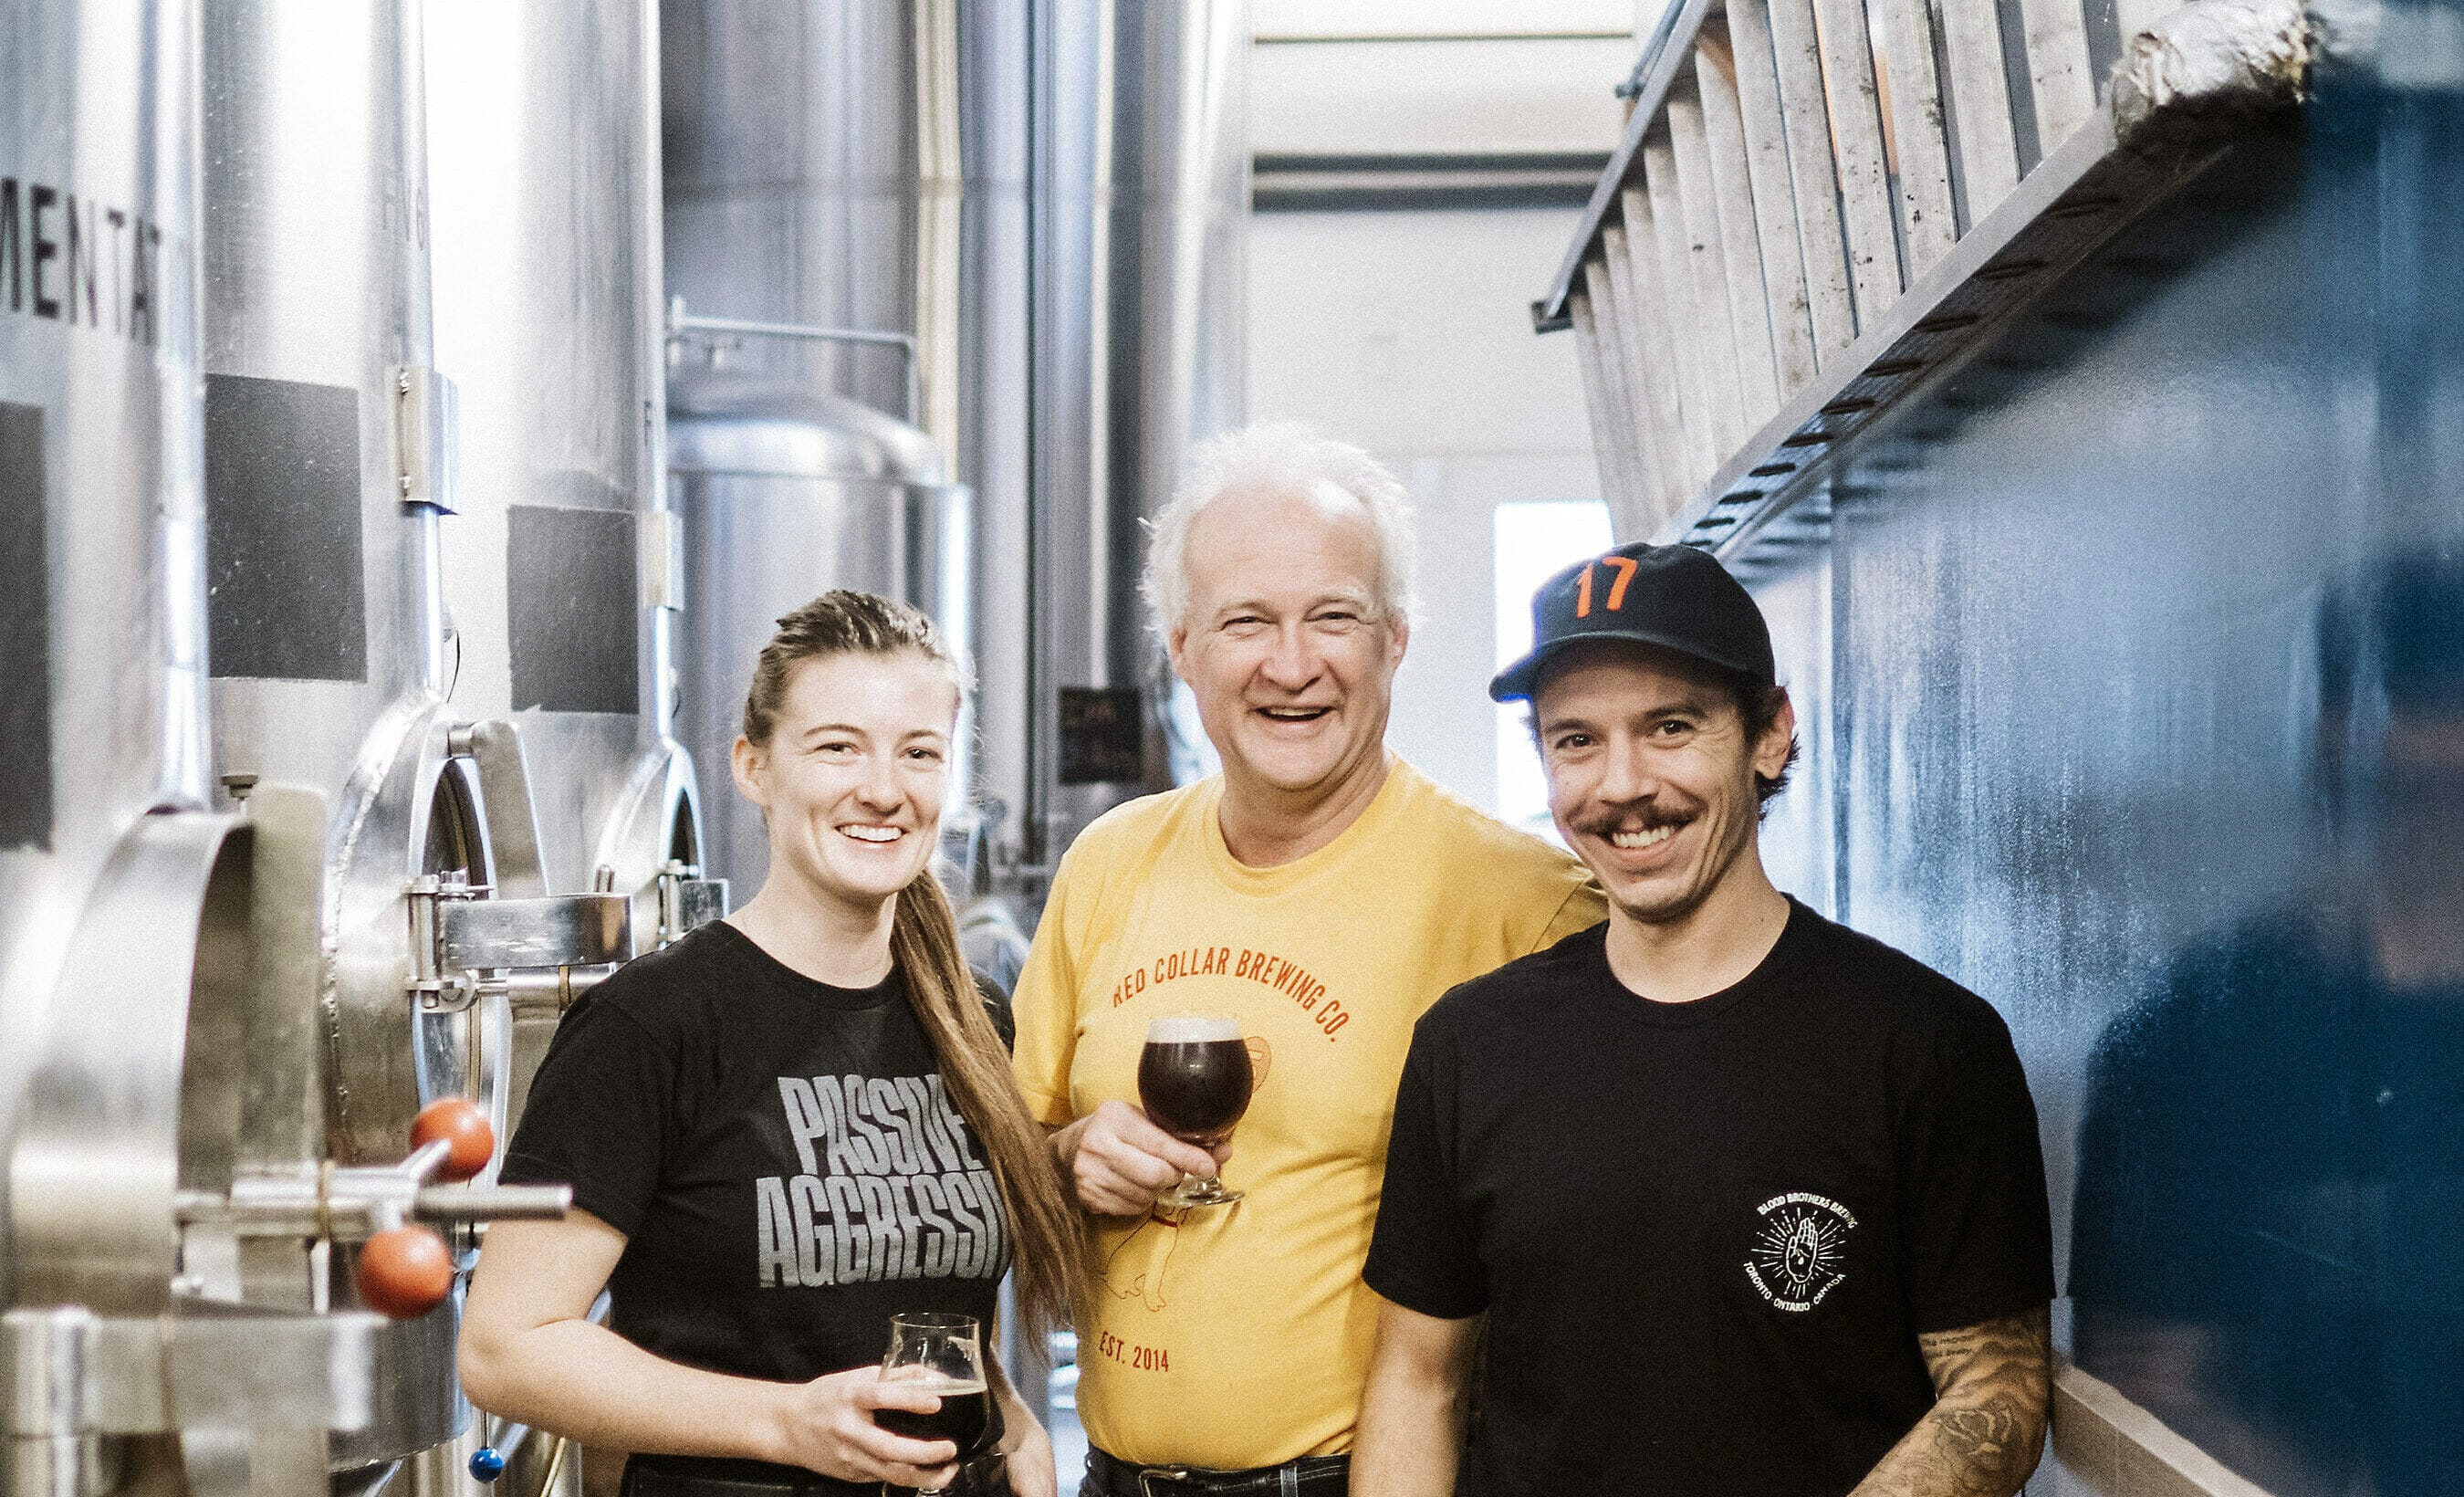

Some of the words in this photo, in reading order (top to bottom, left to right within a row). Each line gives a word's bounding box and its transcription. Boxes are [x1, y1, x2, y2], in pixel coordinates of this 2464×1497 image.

[1577, 556, 1638, 618] 17
[1112, 968, 1145, 1008] RED
[1154, 947, 1230, 984] COLLAR
[1236, 948, 1326, 1011] BREWING
[1315, 1000, 1350, 1042] CO.
[1757, 1196, 1786, 1215] BLOOD
[1786, 1192, 1831, 1209] BROTHERS
[1743, 1261, 1772, 1300] TORONTO
[1773, 1297, 1811, 1312] ONTARIO
[1813, 1273, 1846, 1304] CANADA
[1098, 1330, 1126, 1364] EST.
[1133, 1345, 1169, 1372] 2014
